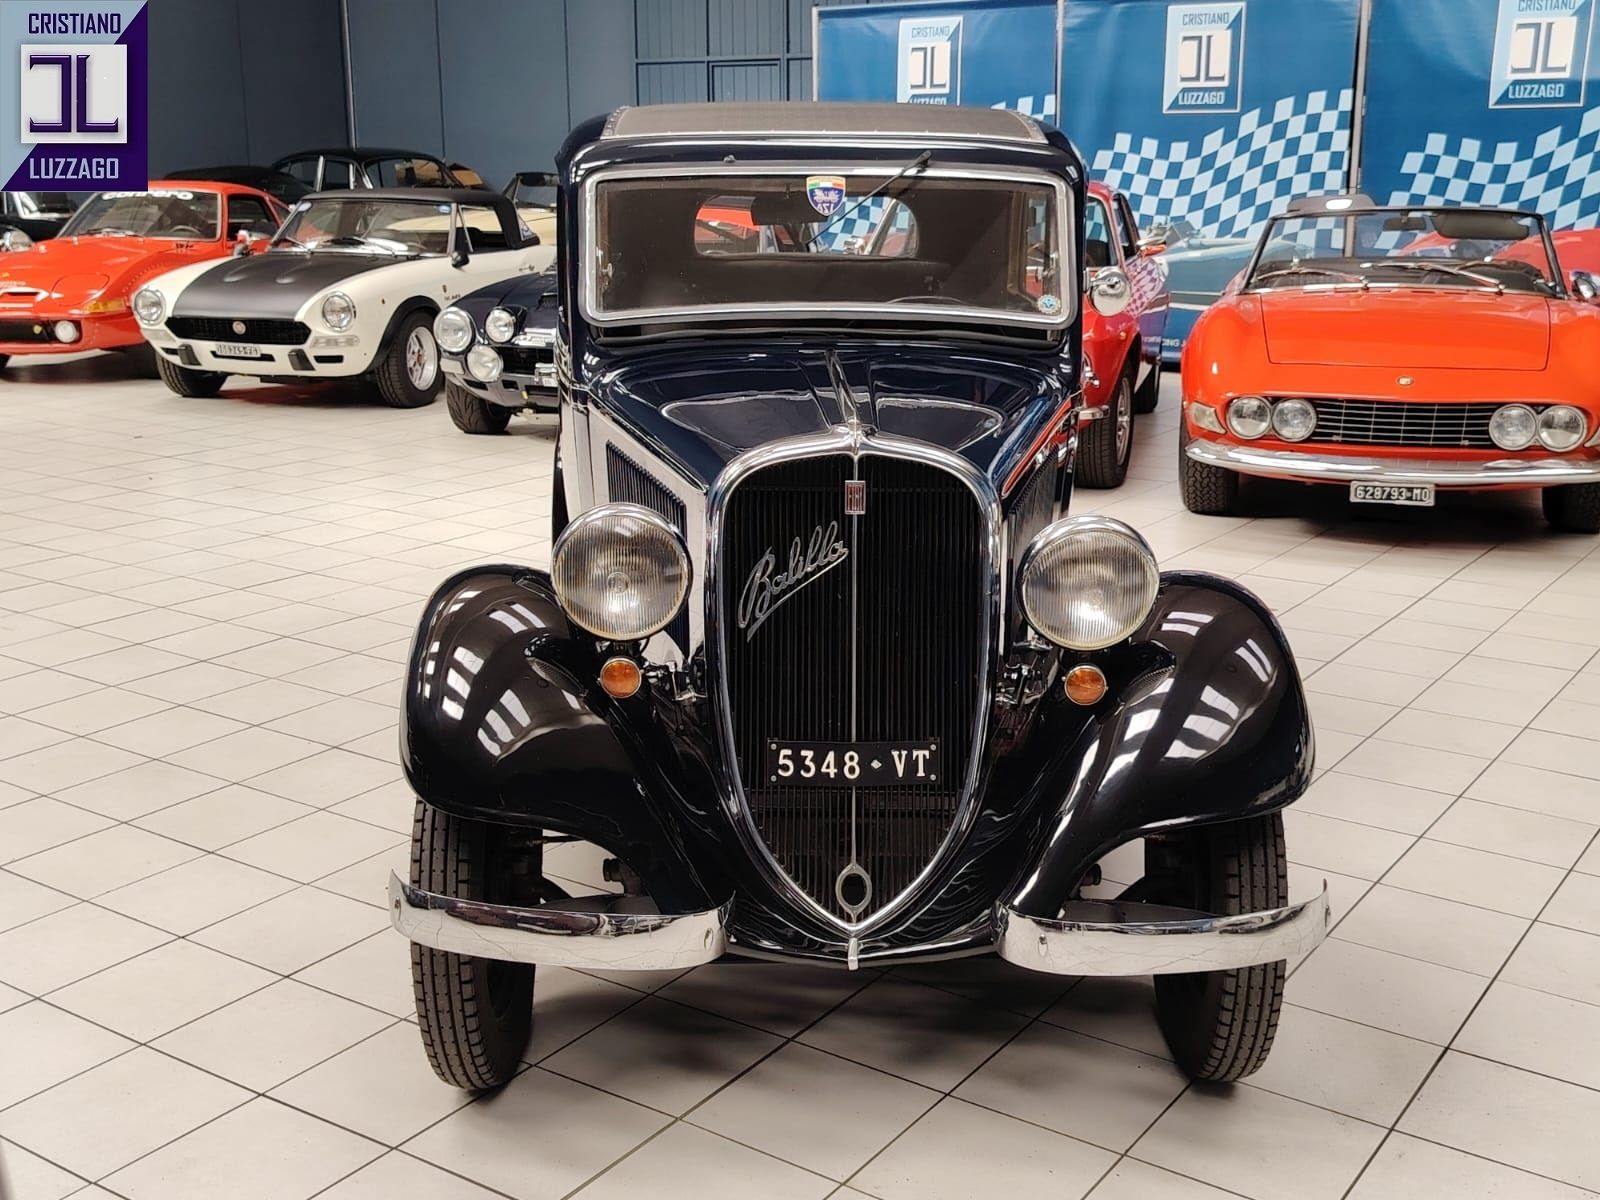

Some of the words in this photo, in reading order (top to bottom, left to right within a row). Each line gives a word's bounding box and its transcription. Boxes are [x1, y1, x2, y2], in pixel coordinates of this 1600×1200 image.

[1517, 0, 1576, 13] CRISTIANO
[1182, 12, 1230, 26] CRISTIANO
[911, 26, 950, 38] CRISTIANO
[1178, 91, 1226, 105] LUZZAGO
[1507, 83, 1565, 99] LUZZAGO
[847, 484, 864, 511] FIAT
[738, 520, 849, 643] Balilla
[777, 749, 861, 780] 5348
[891, 749, 930, 778] VT
